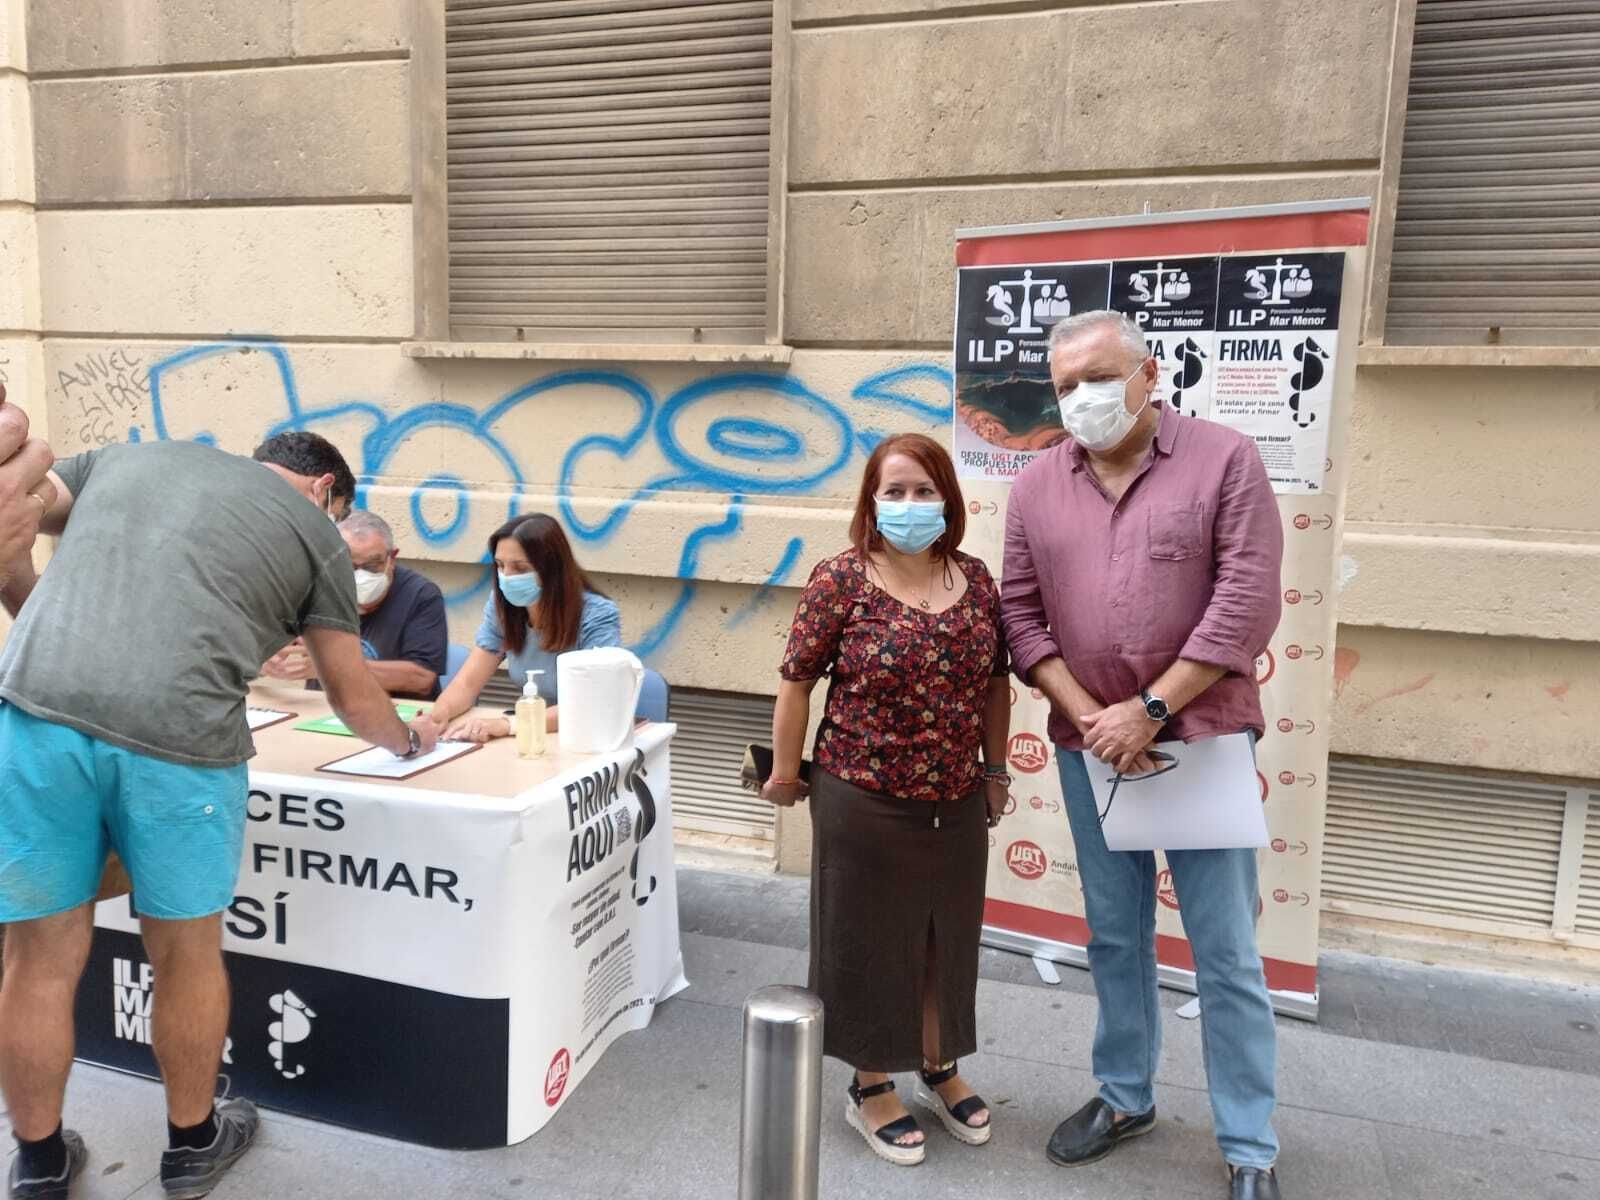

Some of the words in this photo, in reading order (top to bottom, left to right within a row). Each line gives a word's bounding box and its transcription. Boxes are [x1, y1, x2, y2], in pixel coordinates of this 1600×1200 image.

[1152, 318, 1171, 327] Mar
[1173, 317, 1204, 327] Menor
[1228, 309, 1267, 326] ILP
[1269, 316, 1290, 326] Mar
[1292, 315, 1327, 326] Menor
[968, 339, 1014, 362] ILP
[1018, 350, 1043, 363] Mar
[1219, 339, 1283, 361] FIRMA
[961, 450, 989, 460] DESDE
[991, 452, 1011, 462] UGT
[1013, 453, 1036, 463] APO
[964, 457, 1019, 469] PROPUESTA
[984, 467, 996, 475] EL
[1011, 738, 1045, 758] UGT
[563, 761, 619, 832] FIRMA
[1009, 844, 1043, 865] UGT
[253, 842, 474, 912] FIRMAR,
[226, 891, 289, 945] SÍ
